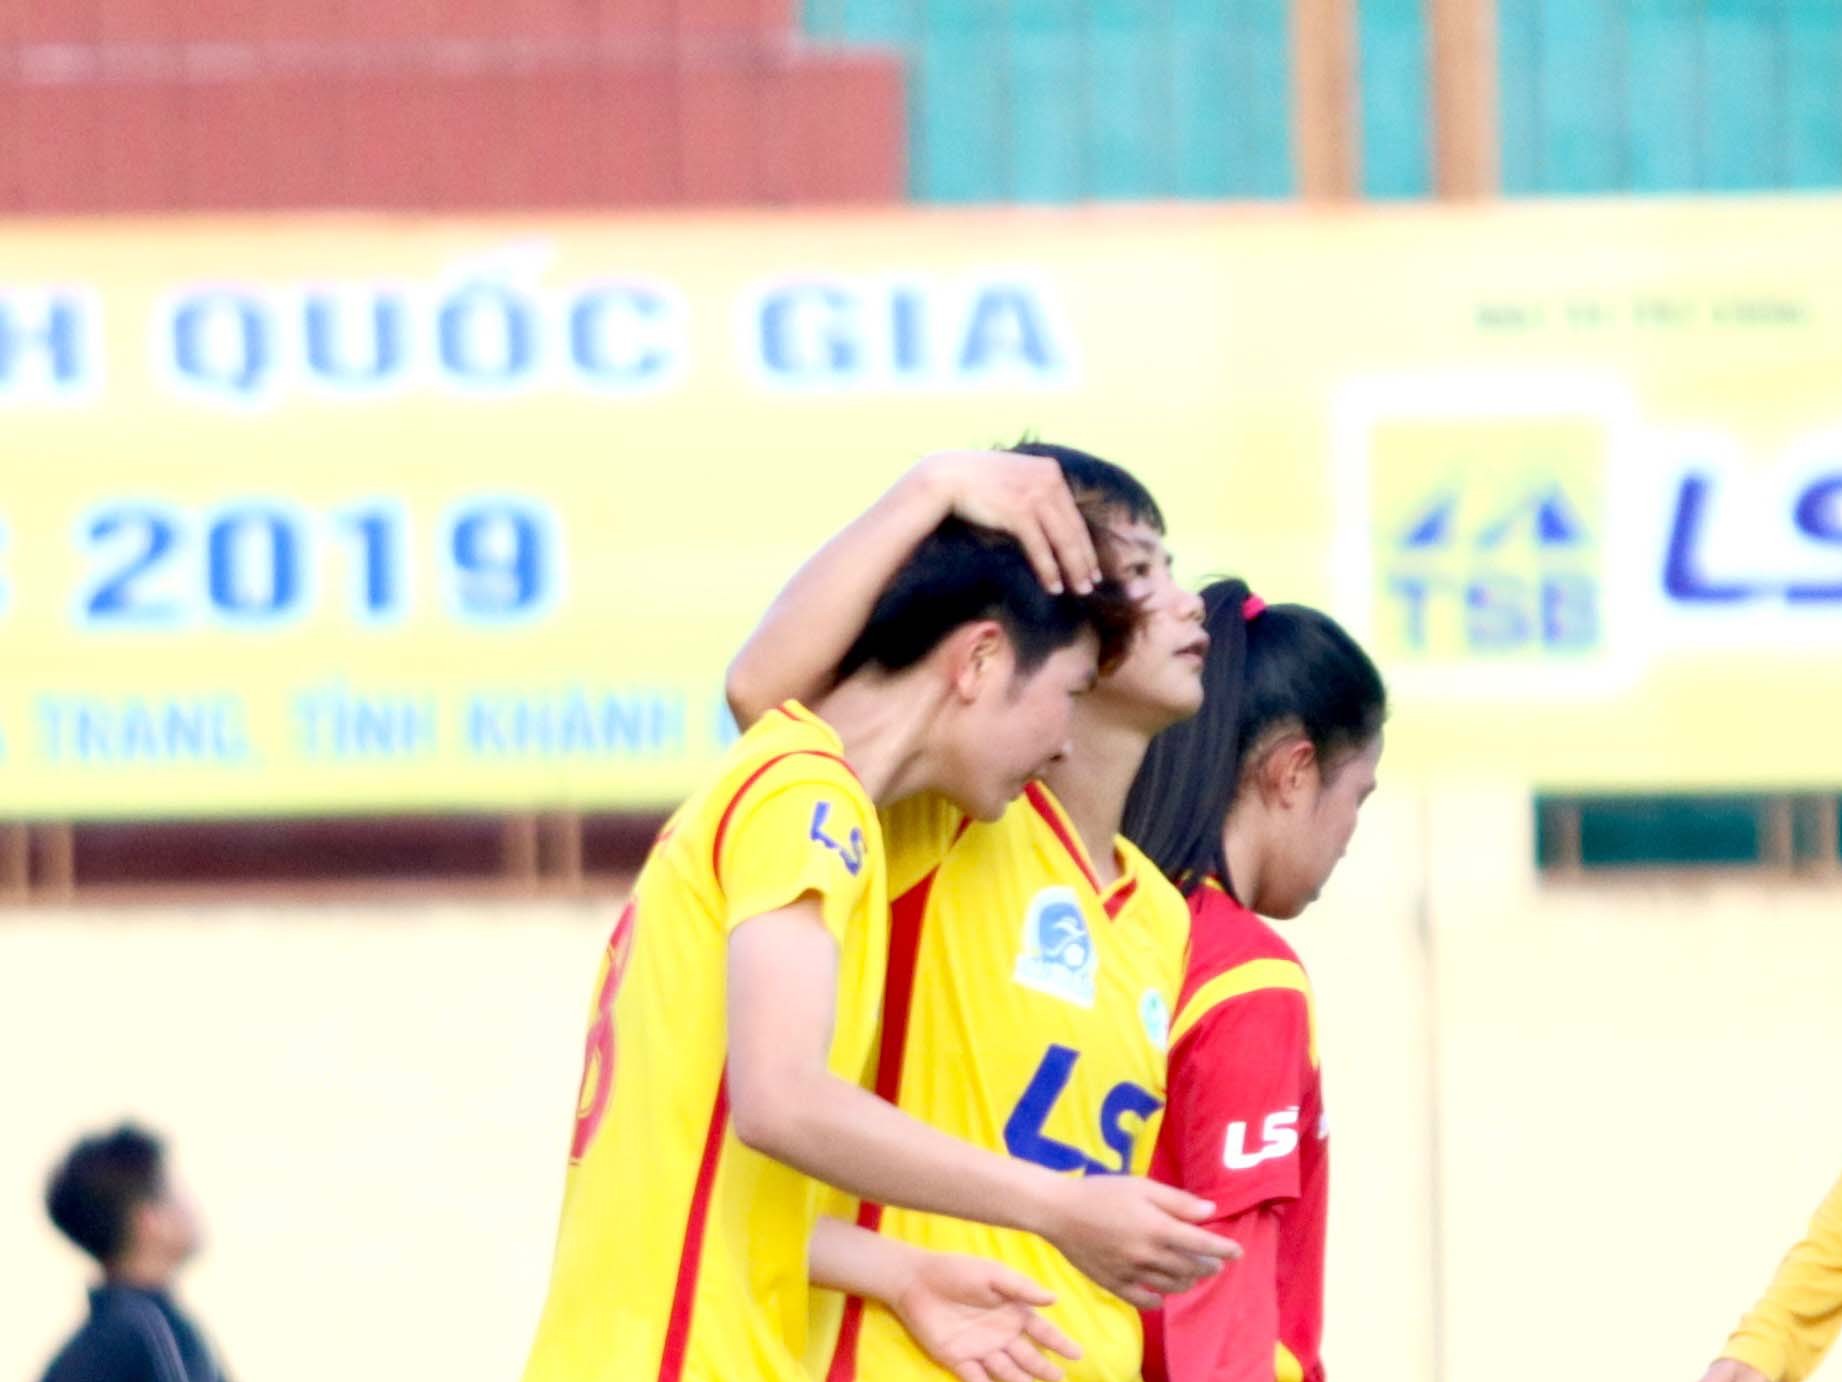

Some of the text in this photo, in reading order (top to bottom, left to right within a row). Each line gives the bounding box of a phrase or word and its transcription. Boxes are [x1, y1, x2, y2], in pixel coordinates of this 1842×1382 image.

[754, 284, 1062, 377] GIA
[83, 500, 550, 618] 2019
[1222, 1108, 1300, 1171] LS
